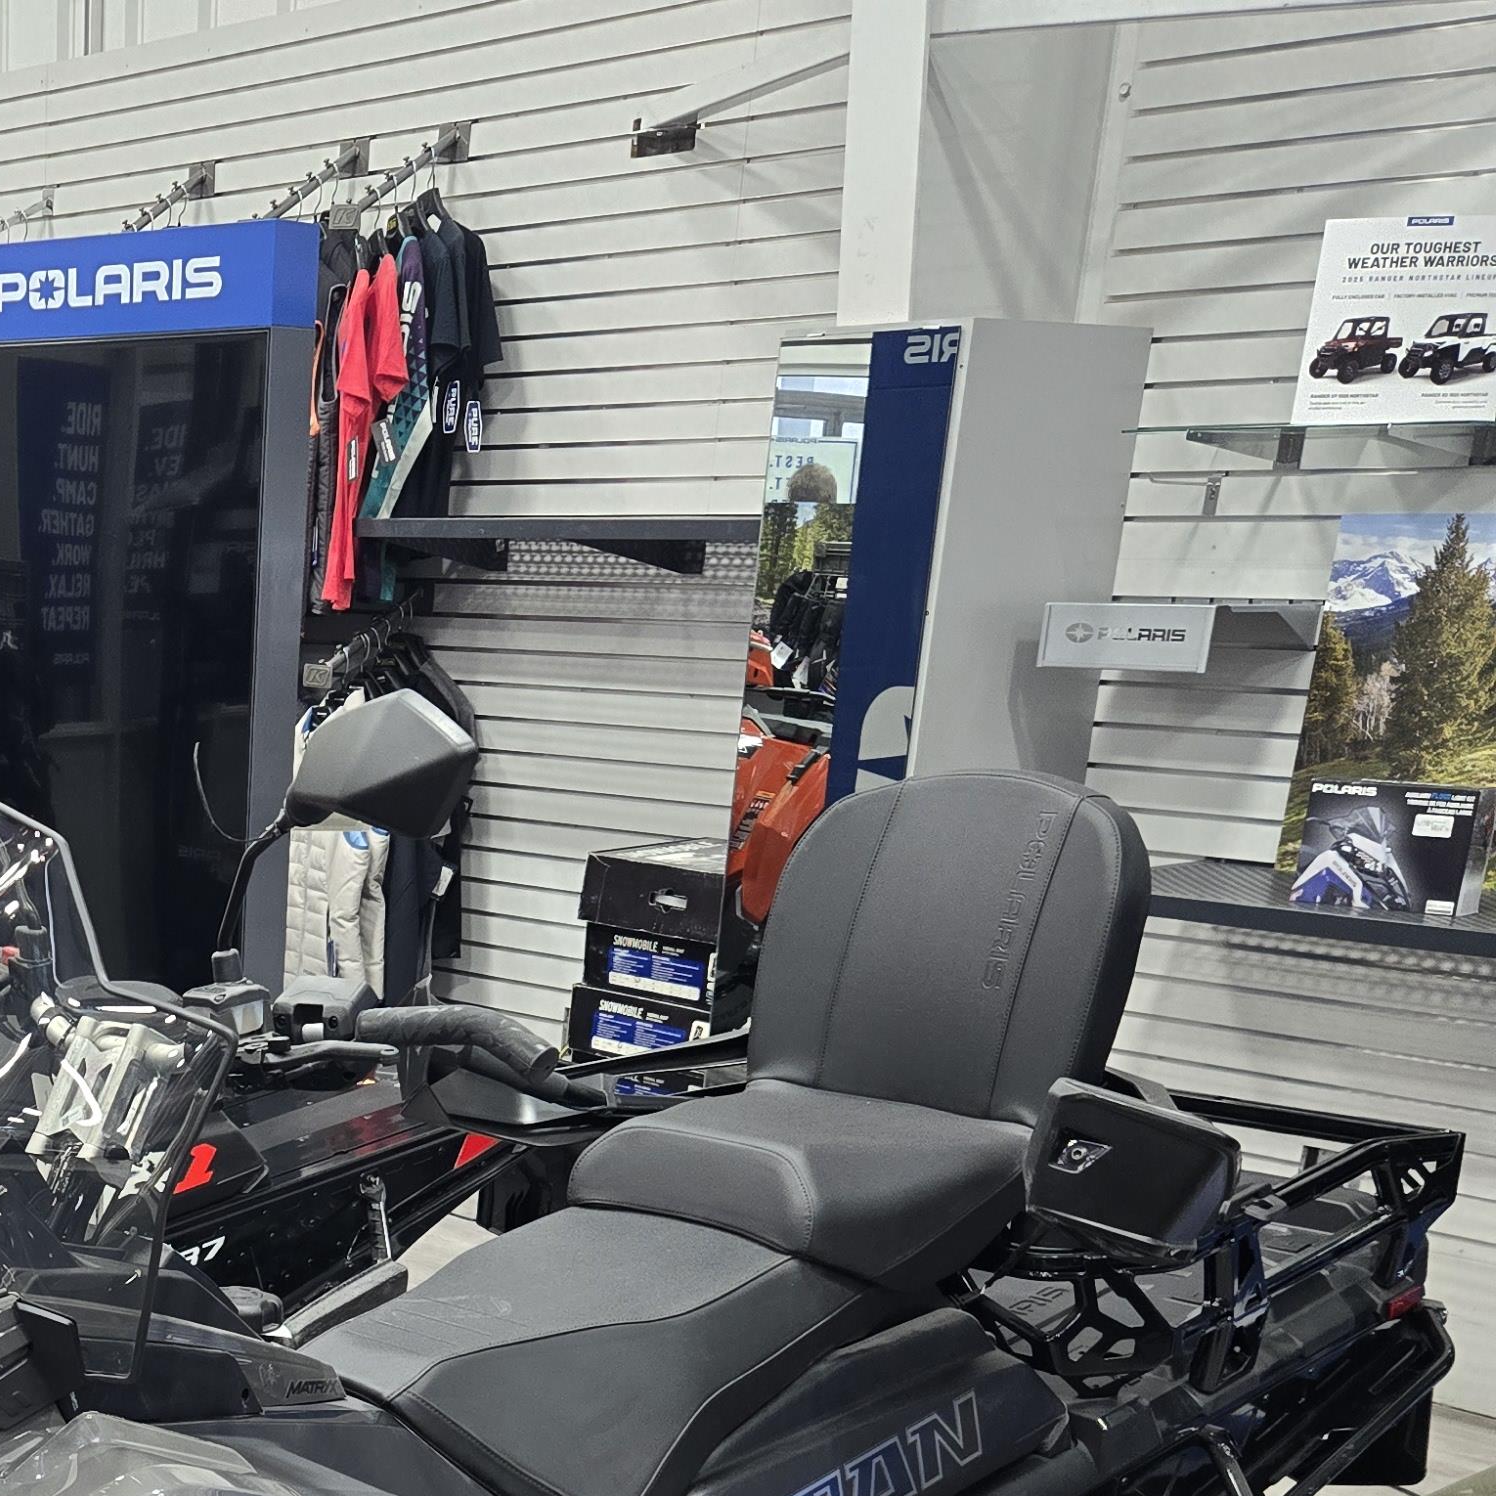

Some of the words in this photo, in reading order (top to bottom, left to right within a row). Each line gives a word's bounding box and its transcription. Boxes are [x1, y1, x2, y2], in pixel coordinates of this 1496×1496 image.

[1411, 217, 1450, 225] POLARIS
[1370, 242, 1401, 255] OUR
[1405, 241, 1482, 253] TOUGHEST
[1347, 256, 1419, 269] WEATHER
[1423, 254, 1496, 268] WARRIORS
[1408, 274, 1461, 282] NORTHSTAR
[1311, 782, 1378, 797] POLARIS
[613, 934, 659, 954] SNOWMOBILE
[599, 999, 644, 1021] SNOWMOBILE
